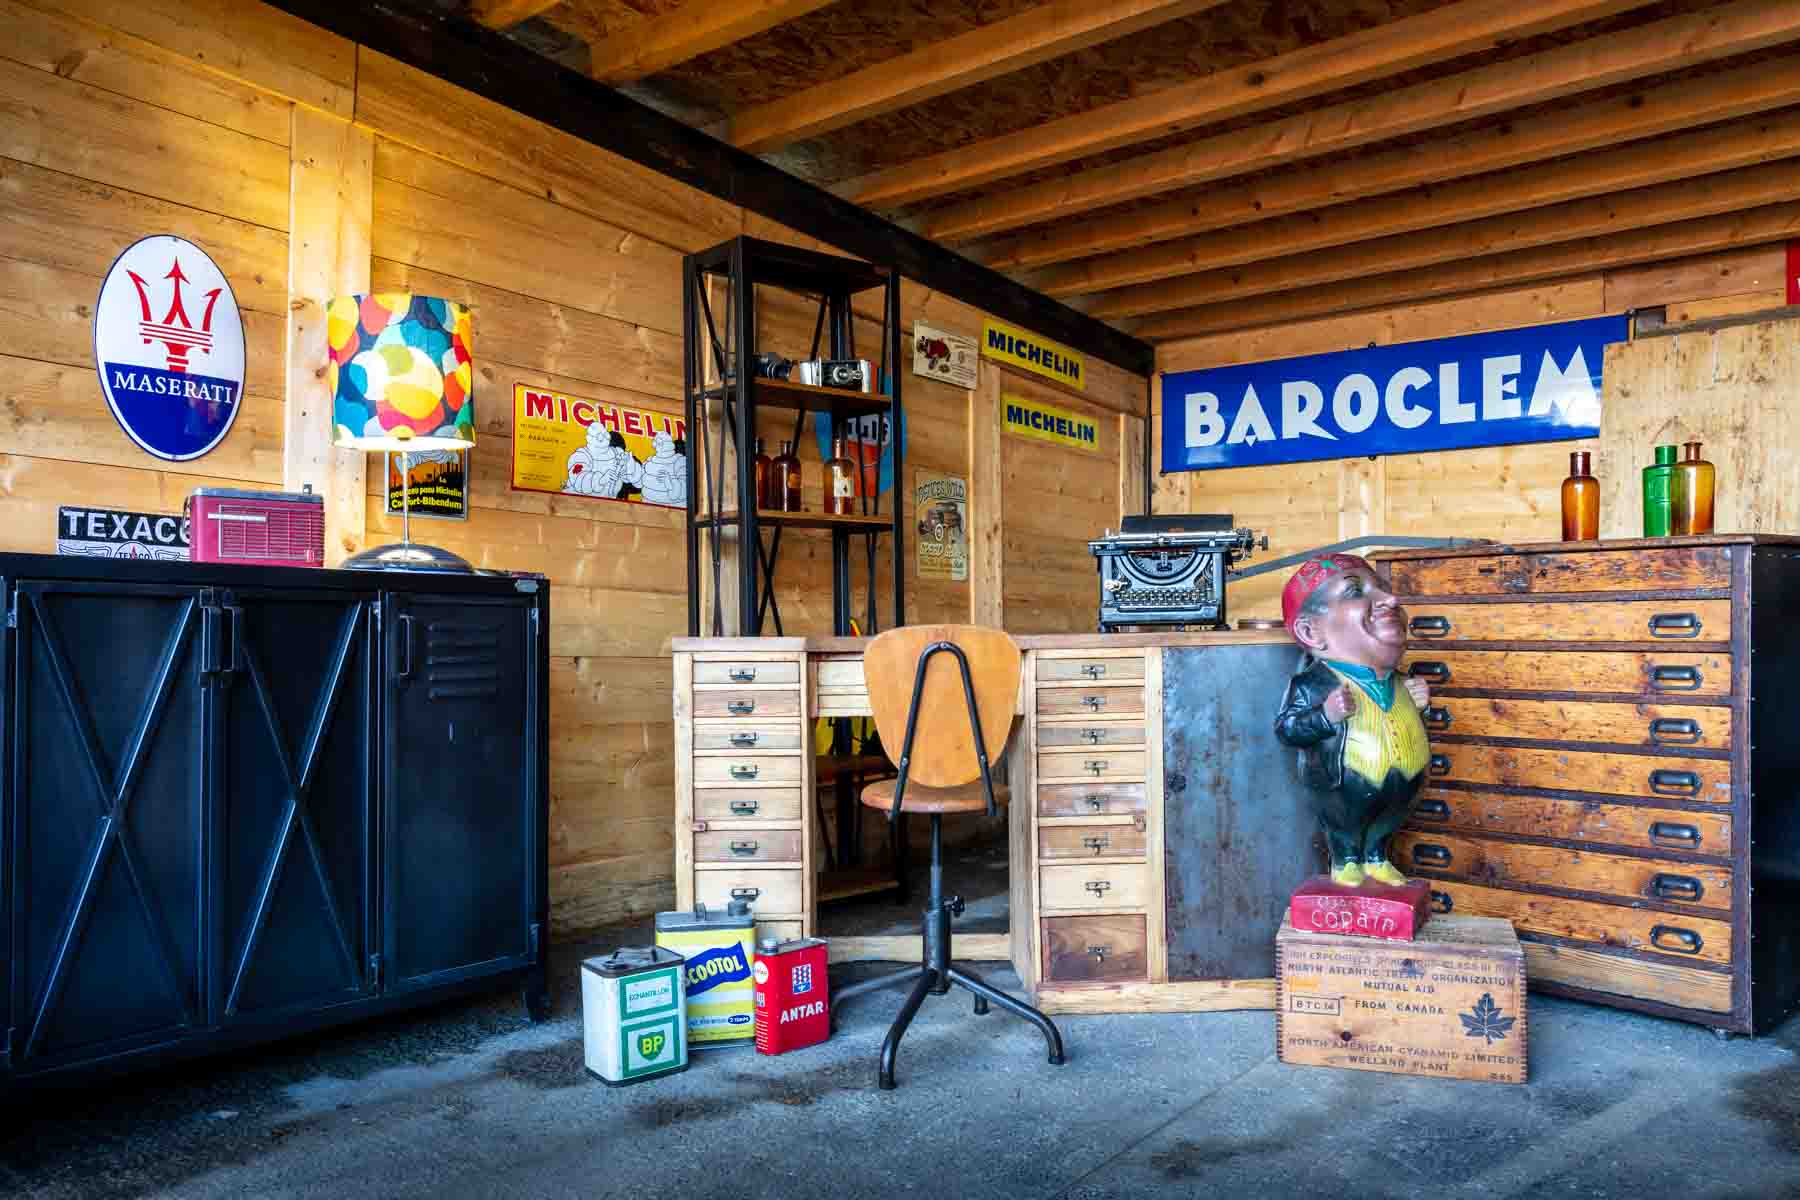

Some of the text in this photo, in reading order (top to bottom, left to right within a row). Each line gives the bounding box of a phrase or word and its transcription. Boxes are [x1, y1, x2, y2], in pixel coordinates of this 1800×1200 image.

[987, 328, 1080, 380] MICHELIN
[113, 370, 233, 404] MASERATI
[1185, 345, 1601, 448] BAROCLEM
[1006, 404, 1095, 443] MICHELIN
[391, 487, 419, 499] noueau
[392, 496, 462, 509] Cofort-Bibendum
[687, 955, 743, 984] COOTOL
[1328, 966, 1379, 977] ATLANTIC
[1363, 981, 1435, 993] MUTUAL AID
[780, 1001, 824, 1024] ANTAR
[1355, 1000, 1444, 1015] FROM CANADA
[642, 1035, 663, 1055] BP
[1288, 1038, 1328, 1047] NORTH
[1332, 1040, 1393, 1053] AMERICAN
